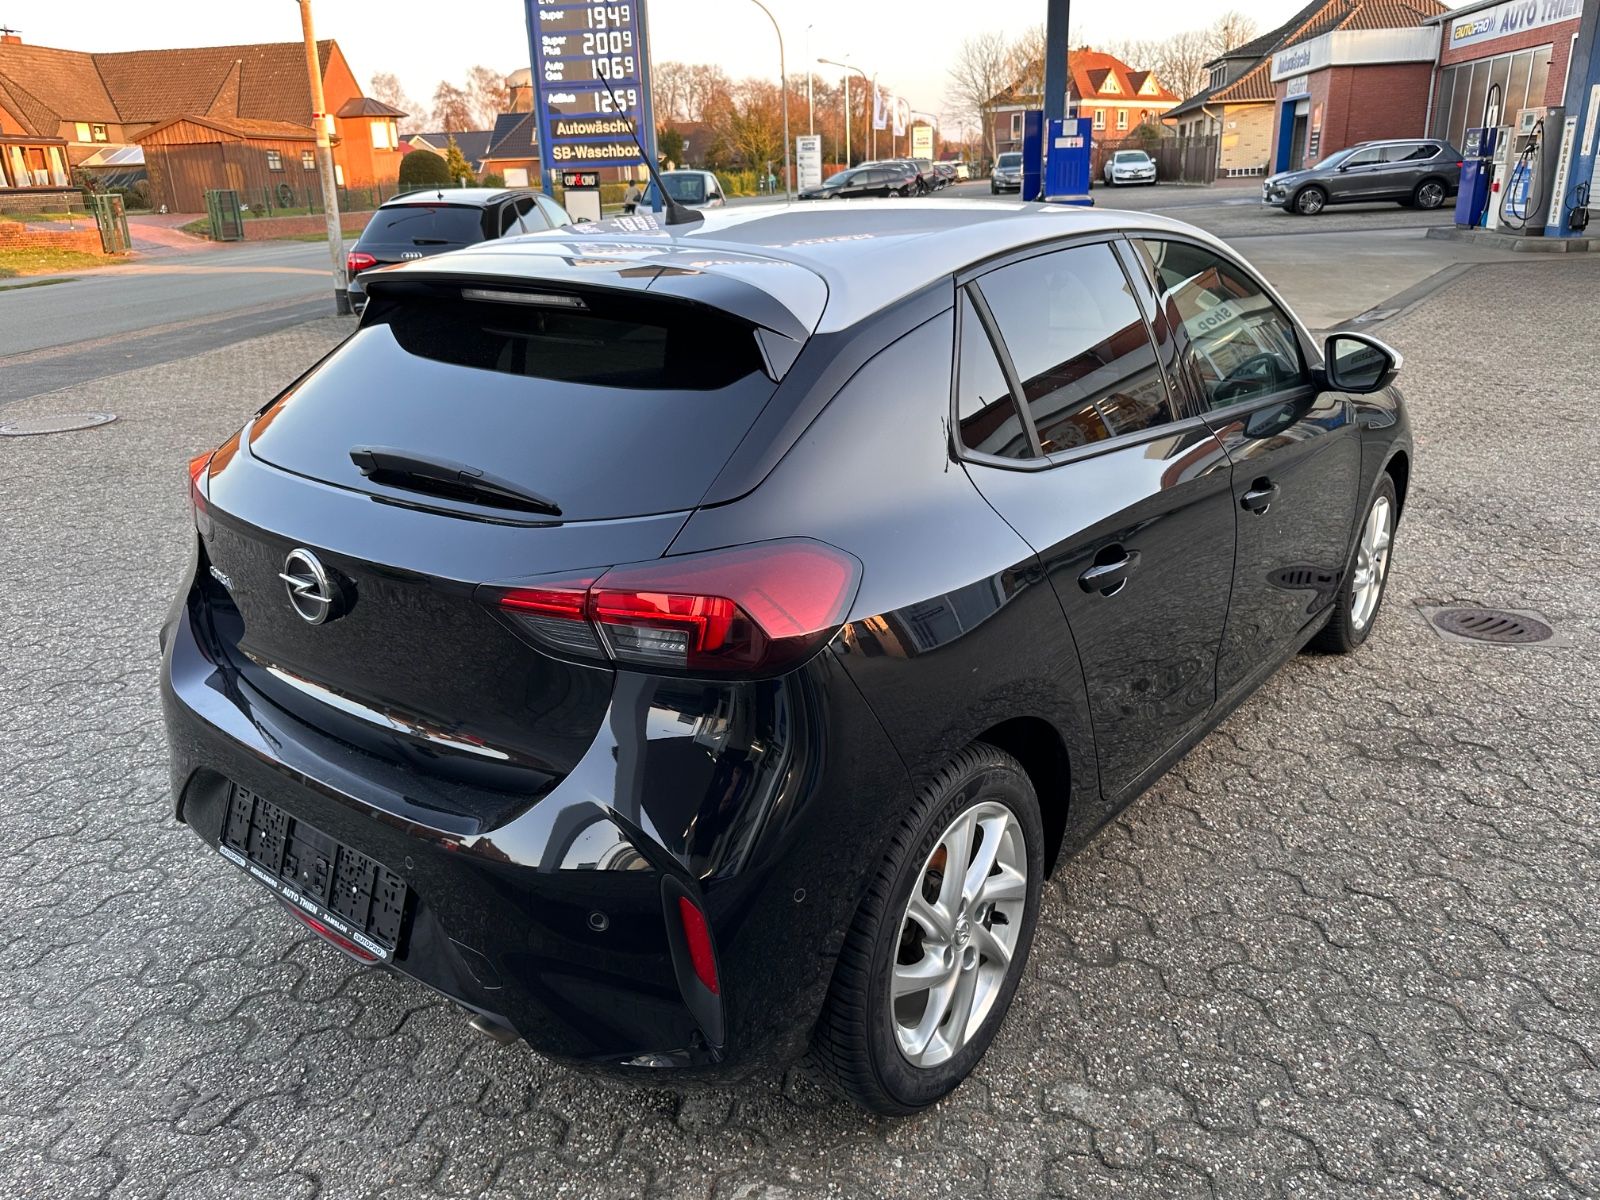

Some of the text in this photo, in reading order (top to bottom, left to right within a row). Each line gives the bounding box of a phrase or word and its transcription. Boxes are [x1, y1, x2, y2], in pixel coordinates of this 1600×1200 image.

[539, 10, 564, 21] Super
[1500, 0, 1537, 33] AUTO
[542, 36, 566, 46] Super
[545, 61, 564, 71] Auto
[556, 120, 633, 135] Autowäsche
[552, 144, 641, 160] SB-Waschbox
[1551, 128, 1572, 223] TANKAUTOMAT
[911, 792, 967, 872] KUMHO
[282, 887, 299, 902] AUTO
[300, 896, 318, 914] THIEN
